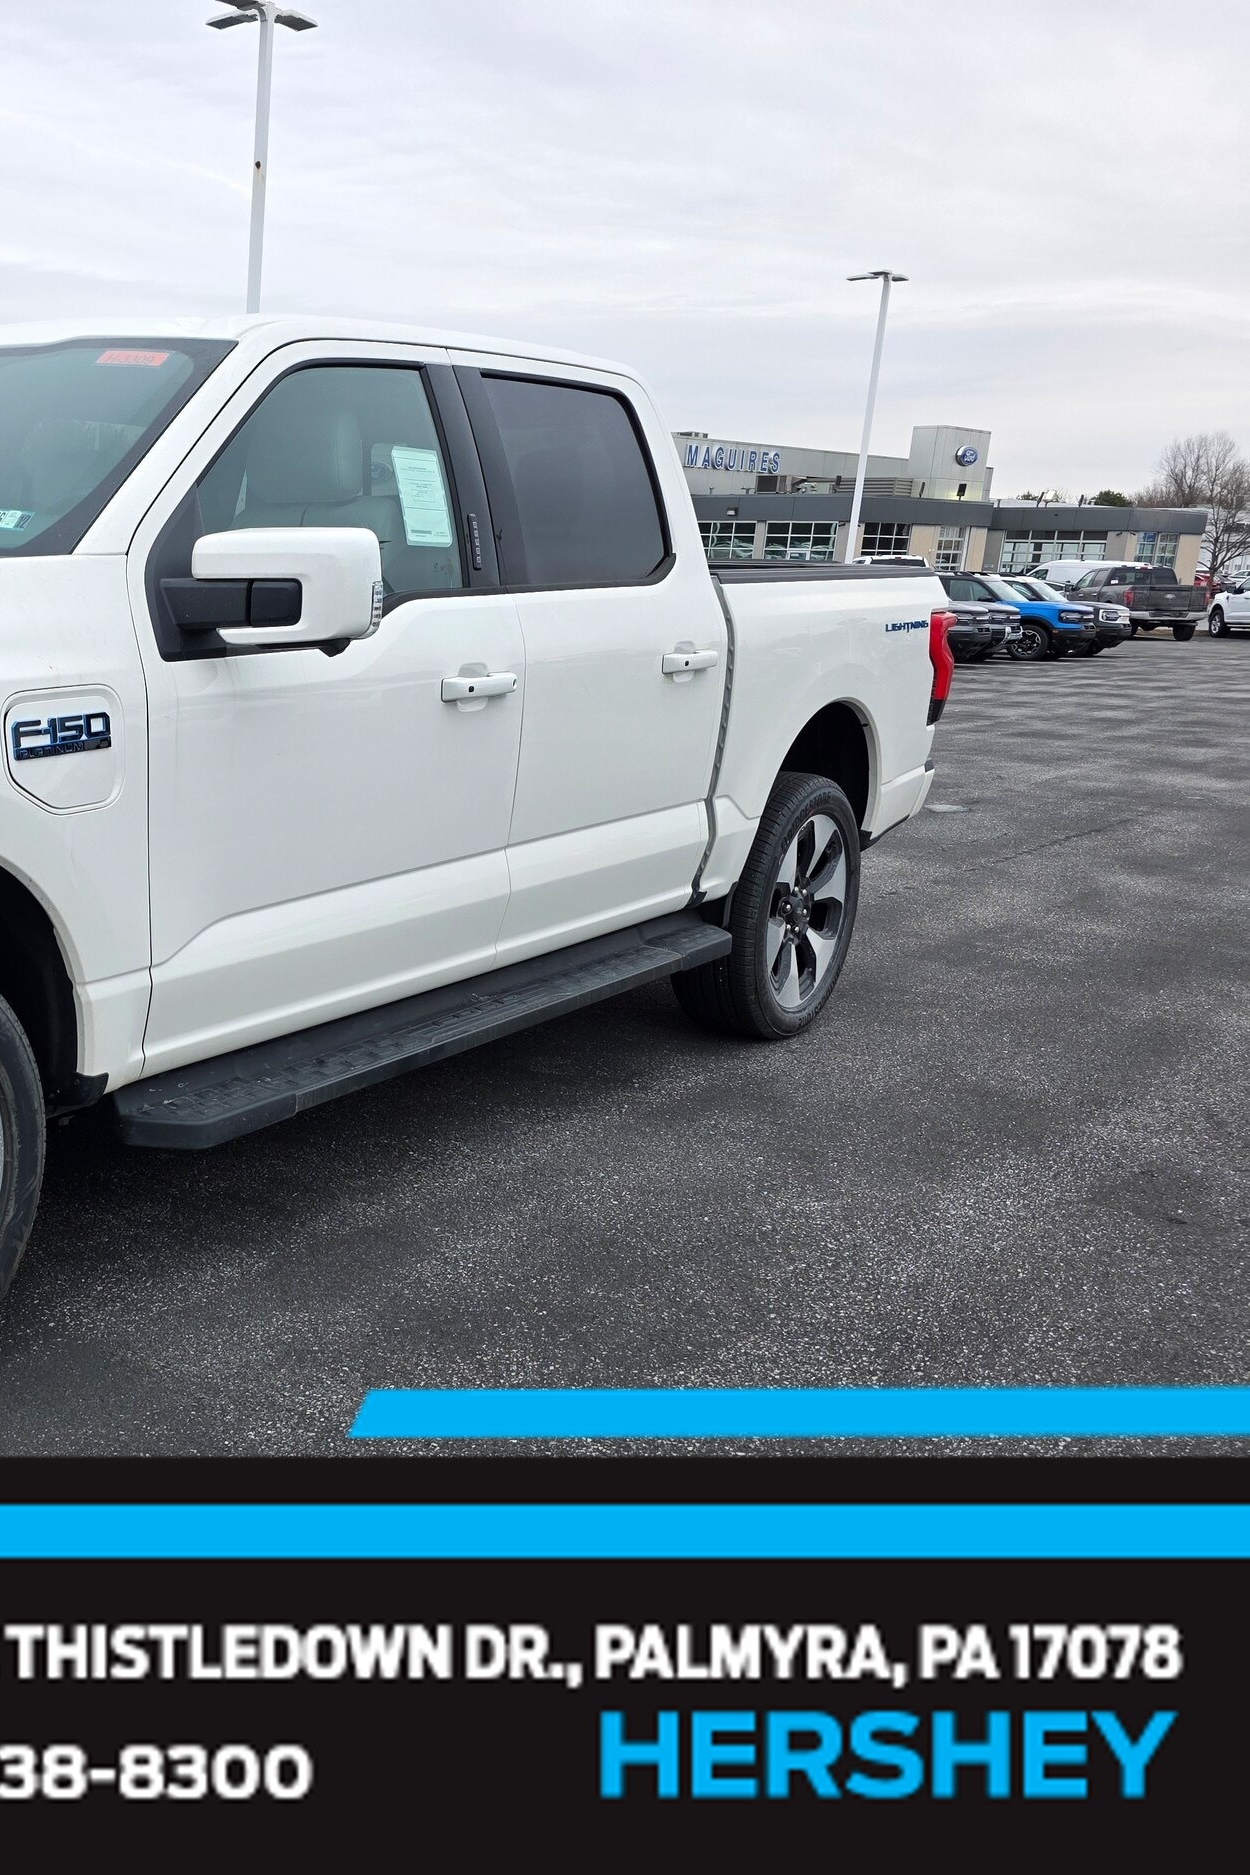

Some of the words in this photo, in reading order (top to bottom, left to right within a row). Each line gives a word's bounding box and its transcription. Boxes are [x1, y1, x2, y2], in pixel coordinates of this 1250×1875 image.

[685, 444, 781, 474] MAGUIRES
[885, 620, 929, 633] LIGHTNING
[11, 711, 111, 749] F-150
[18, 741, 86, 759] PLATINUM
